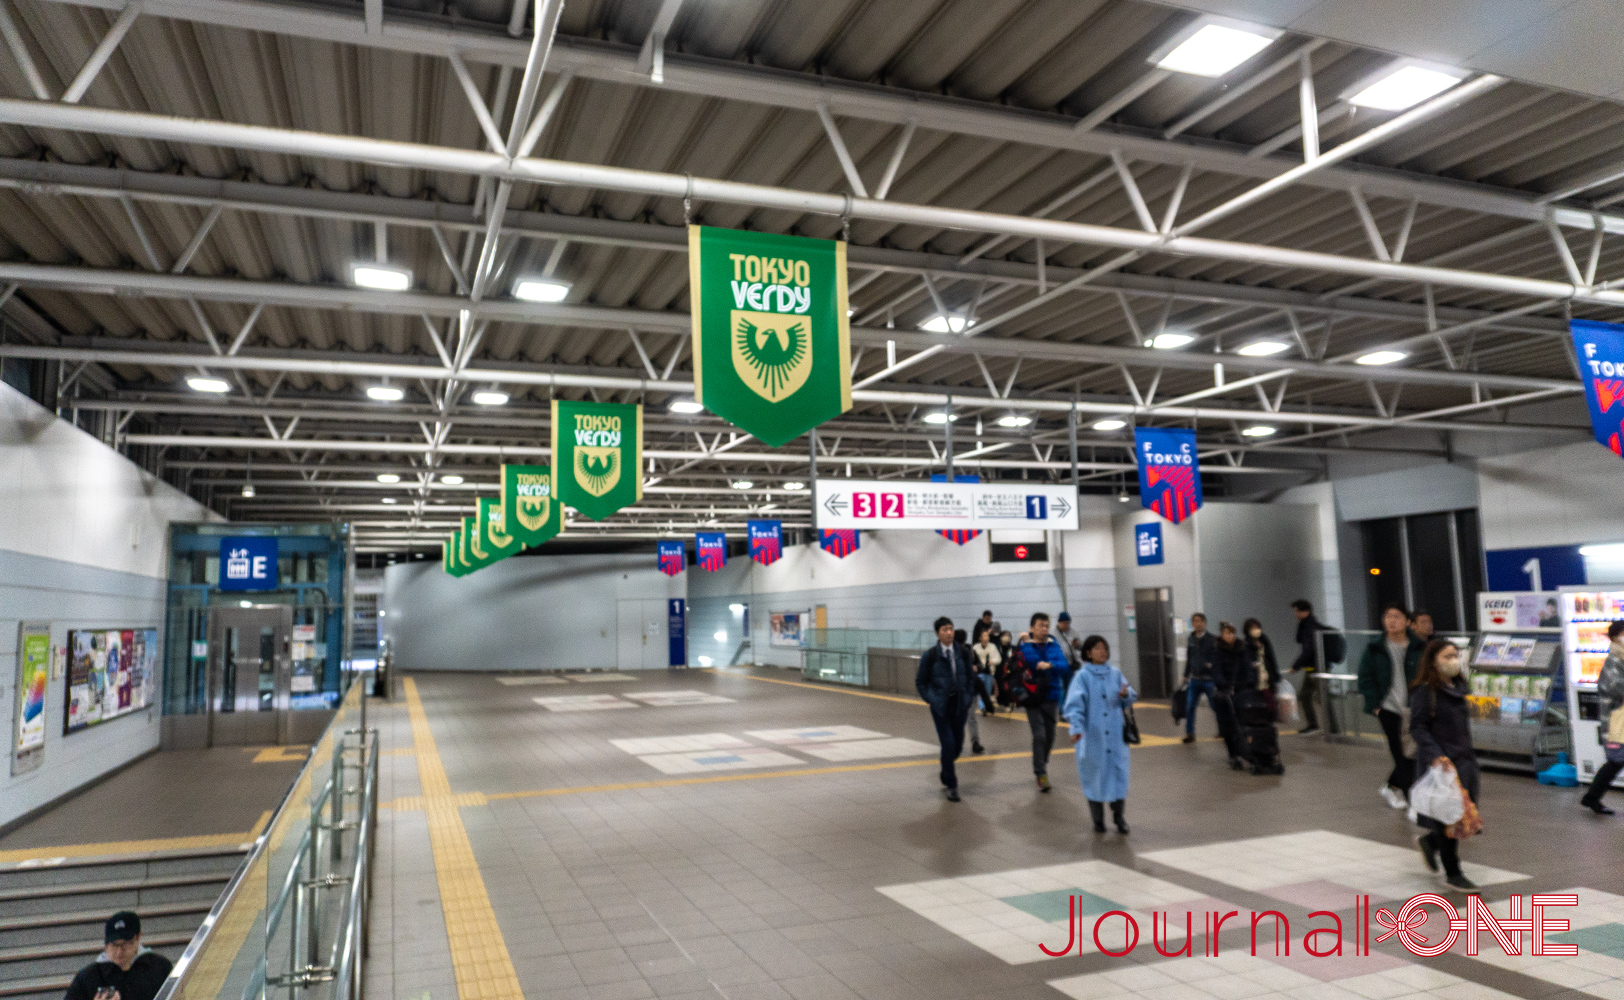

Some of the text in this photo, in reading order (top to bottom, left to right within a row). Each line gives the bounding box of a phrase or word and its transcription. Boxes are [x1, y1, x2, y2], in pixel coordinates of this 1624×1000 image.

[729, 253, 811, 287] TOKYO
[1584, 343, 1597, 358] F
[1587, 360, 1624, 377] TOK
[574, 415, 621, 432] TOKYO
[1144, 453, 1192, 464] TOKYO
[517, 474, 550, 485] TOKYO
[857, 493, 900, 517] 3 2
[1031, 497, 1041, 518] 1
[252, 556, 267, 578] E
[1522, 558, 1543, 592] 1
[673, 600, 681, 615] 1
